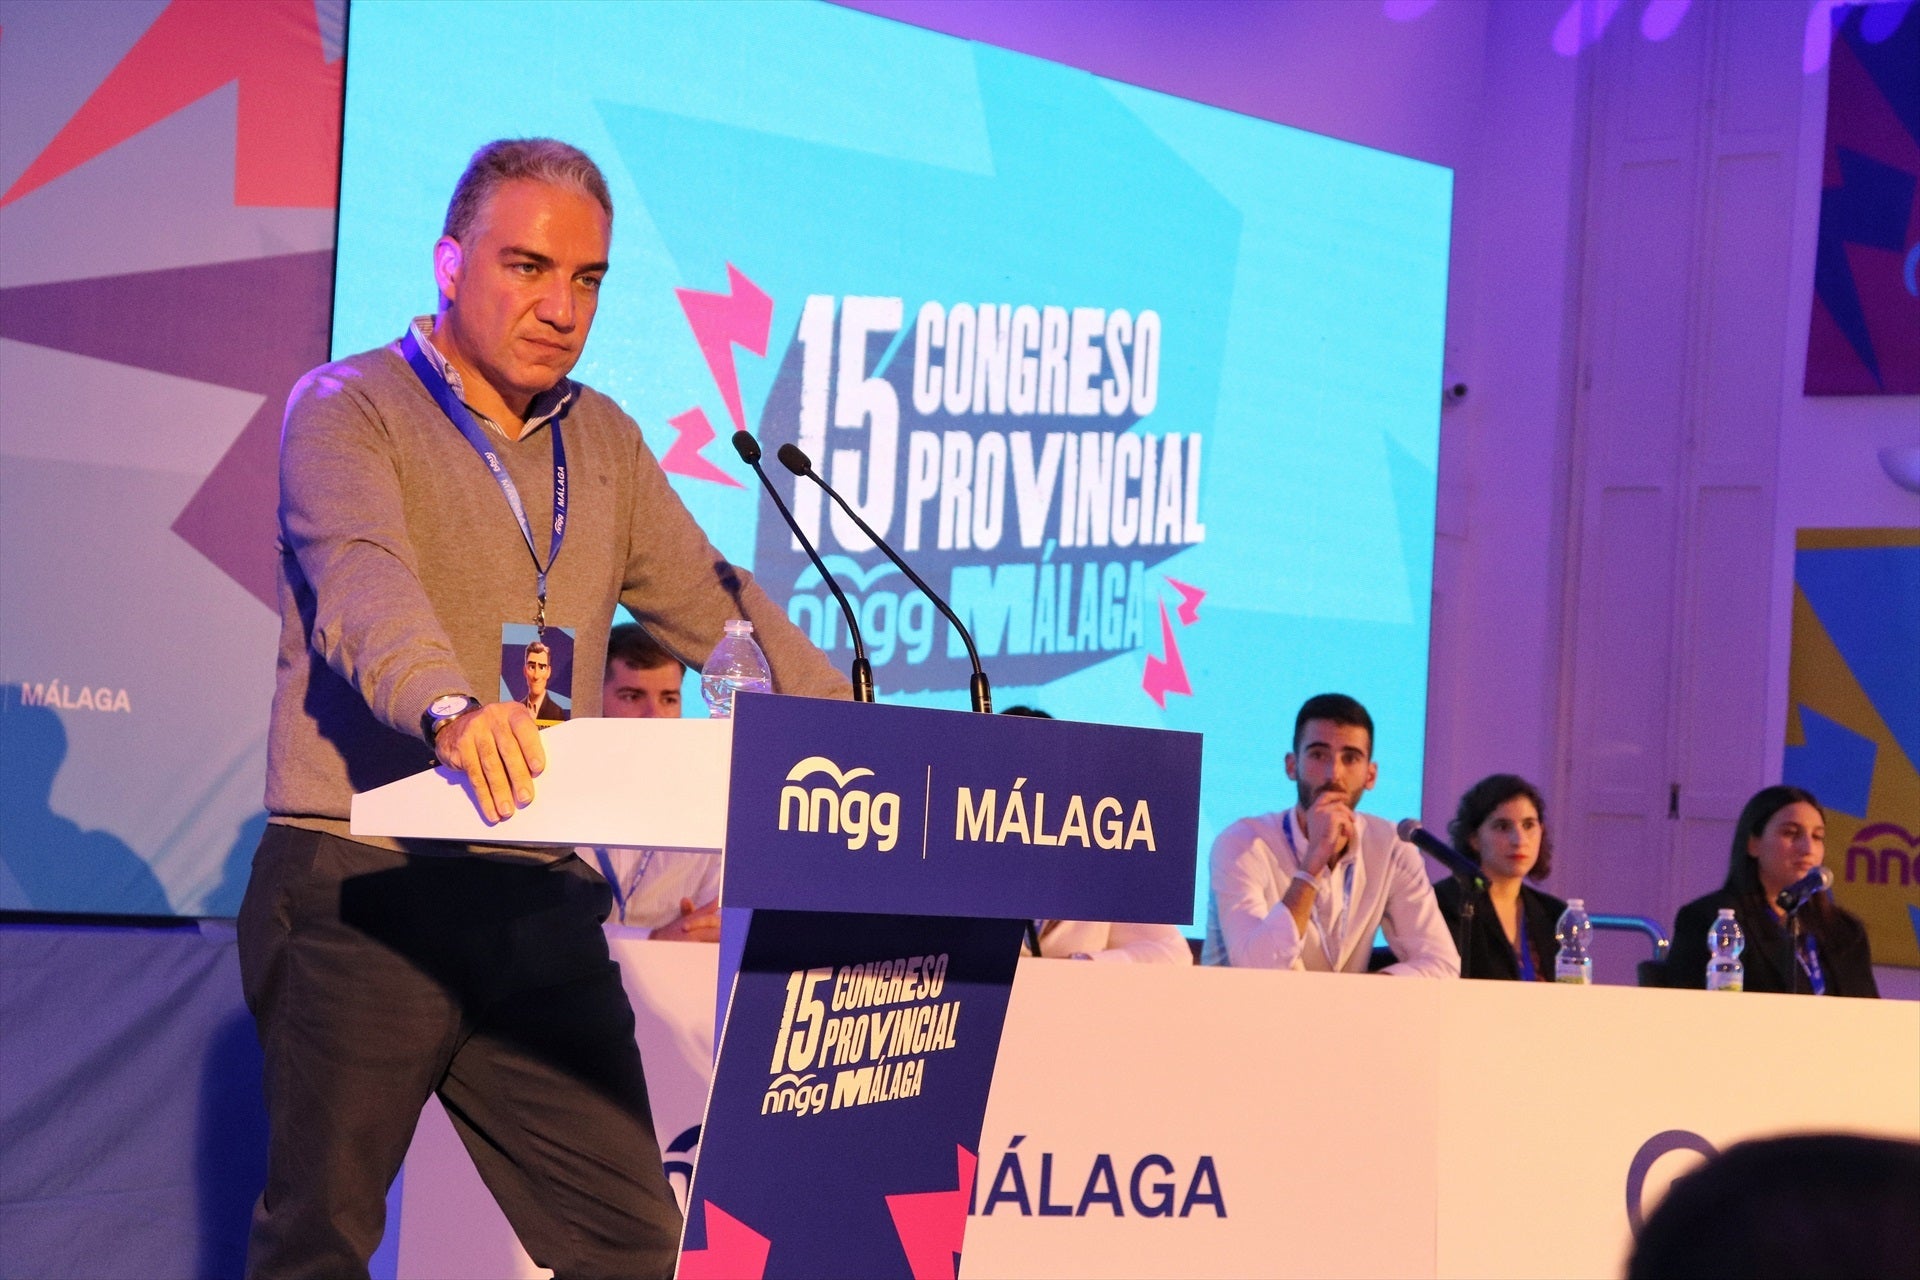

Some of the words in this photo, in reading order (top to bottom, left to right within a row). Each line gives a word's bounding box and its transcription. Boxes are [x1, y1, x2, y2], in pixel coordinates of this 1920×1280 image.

[912, 300, 1162, 418] CONGRESO
[791, 294, 903, 552] 15
[556, 466, 565, 508] MÁLAGA
[903, 430, 1206, 551] PROVINCIAL
[947, 540, 1146, 659] MÁLAGA
[21, 678, 132, 714] MÁLAGA
[954, 777, 1157, 852] MÁLAGA
[769, 967, 834, 1075] 15
[831, 953, 950, 1012] CONGRESO
[817, 1001, 961, 1069] PROVINCIAL
[830, 1055, 925, 1111] MÁLAGA
[967, 1134, 1228, 1219] ÁLAGA
